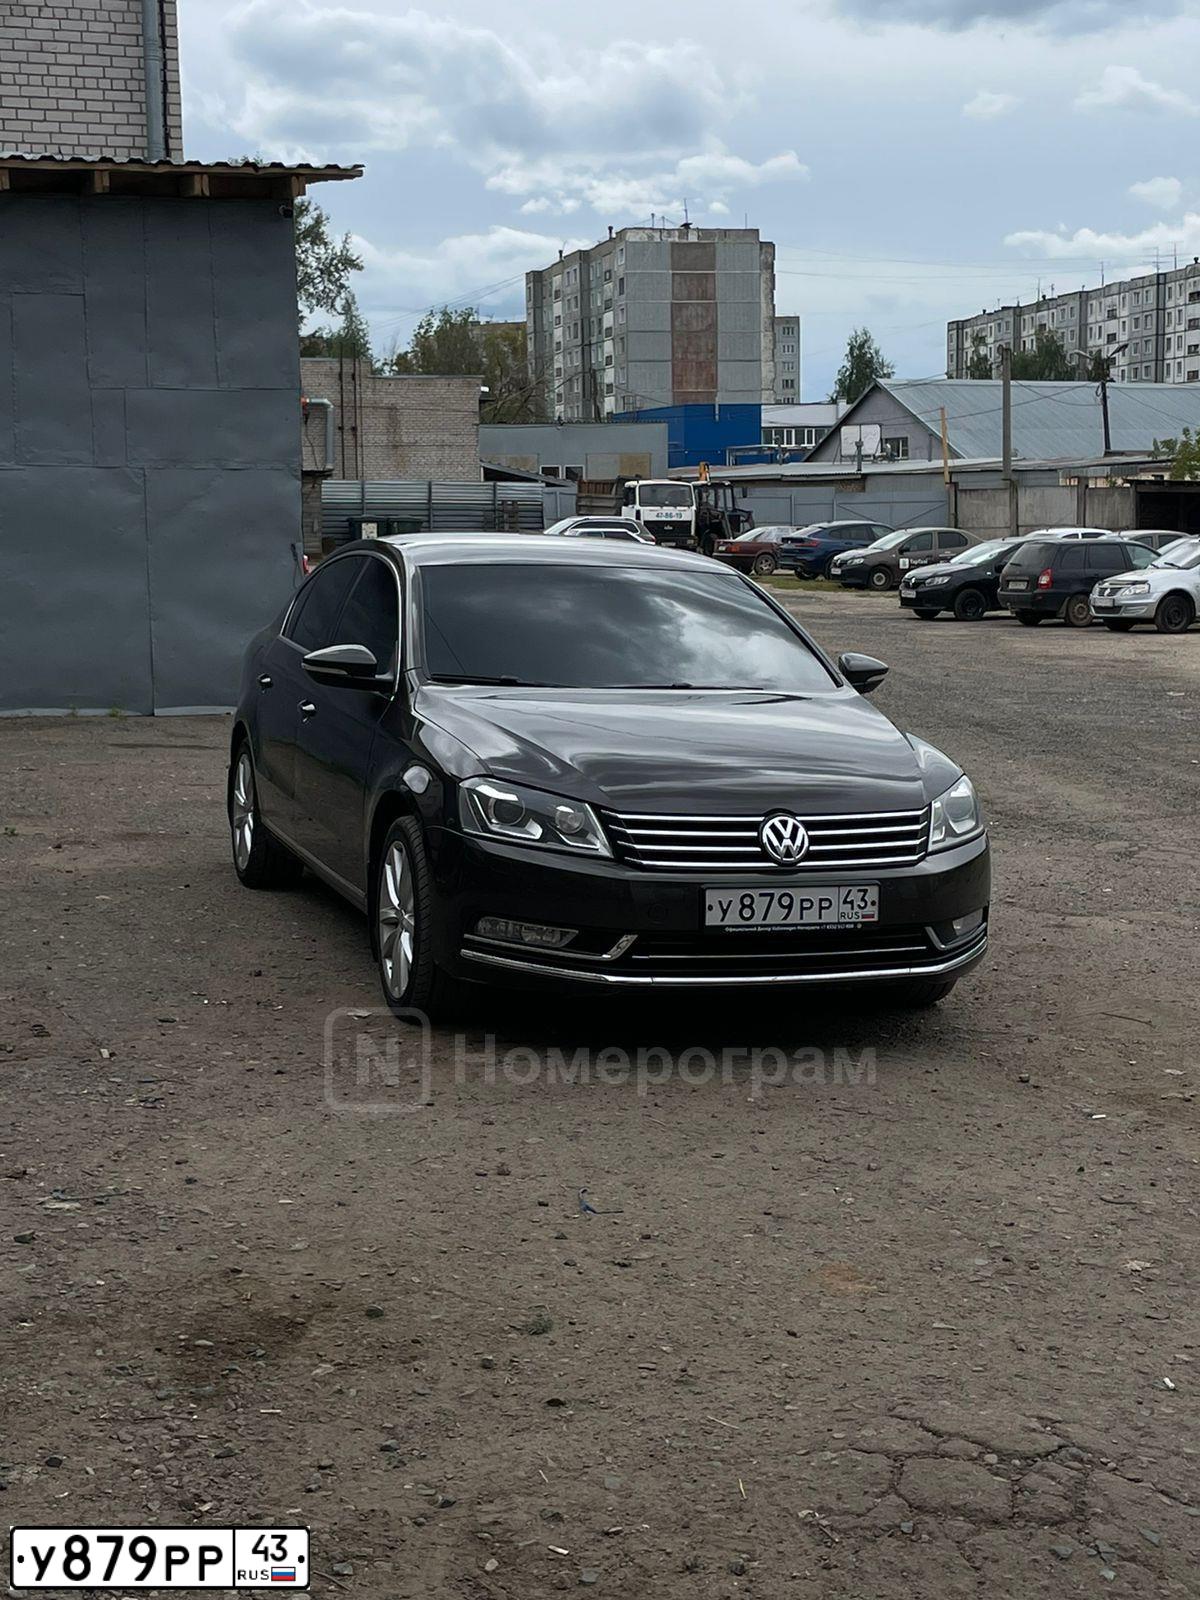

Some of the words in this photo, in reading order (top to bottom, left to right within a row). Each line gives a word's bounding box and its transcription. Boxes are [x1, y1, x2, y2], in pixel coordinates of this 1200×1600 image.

[717, 892, 833, 922] У879РР
[842, 888, 869, 910] 43
[840, 911, 860, 920] RUS
